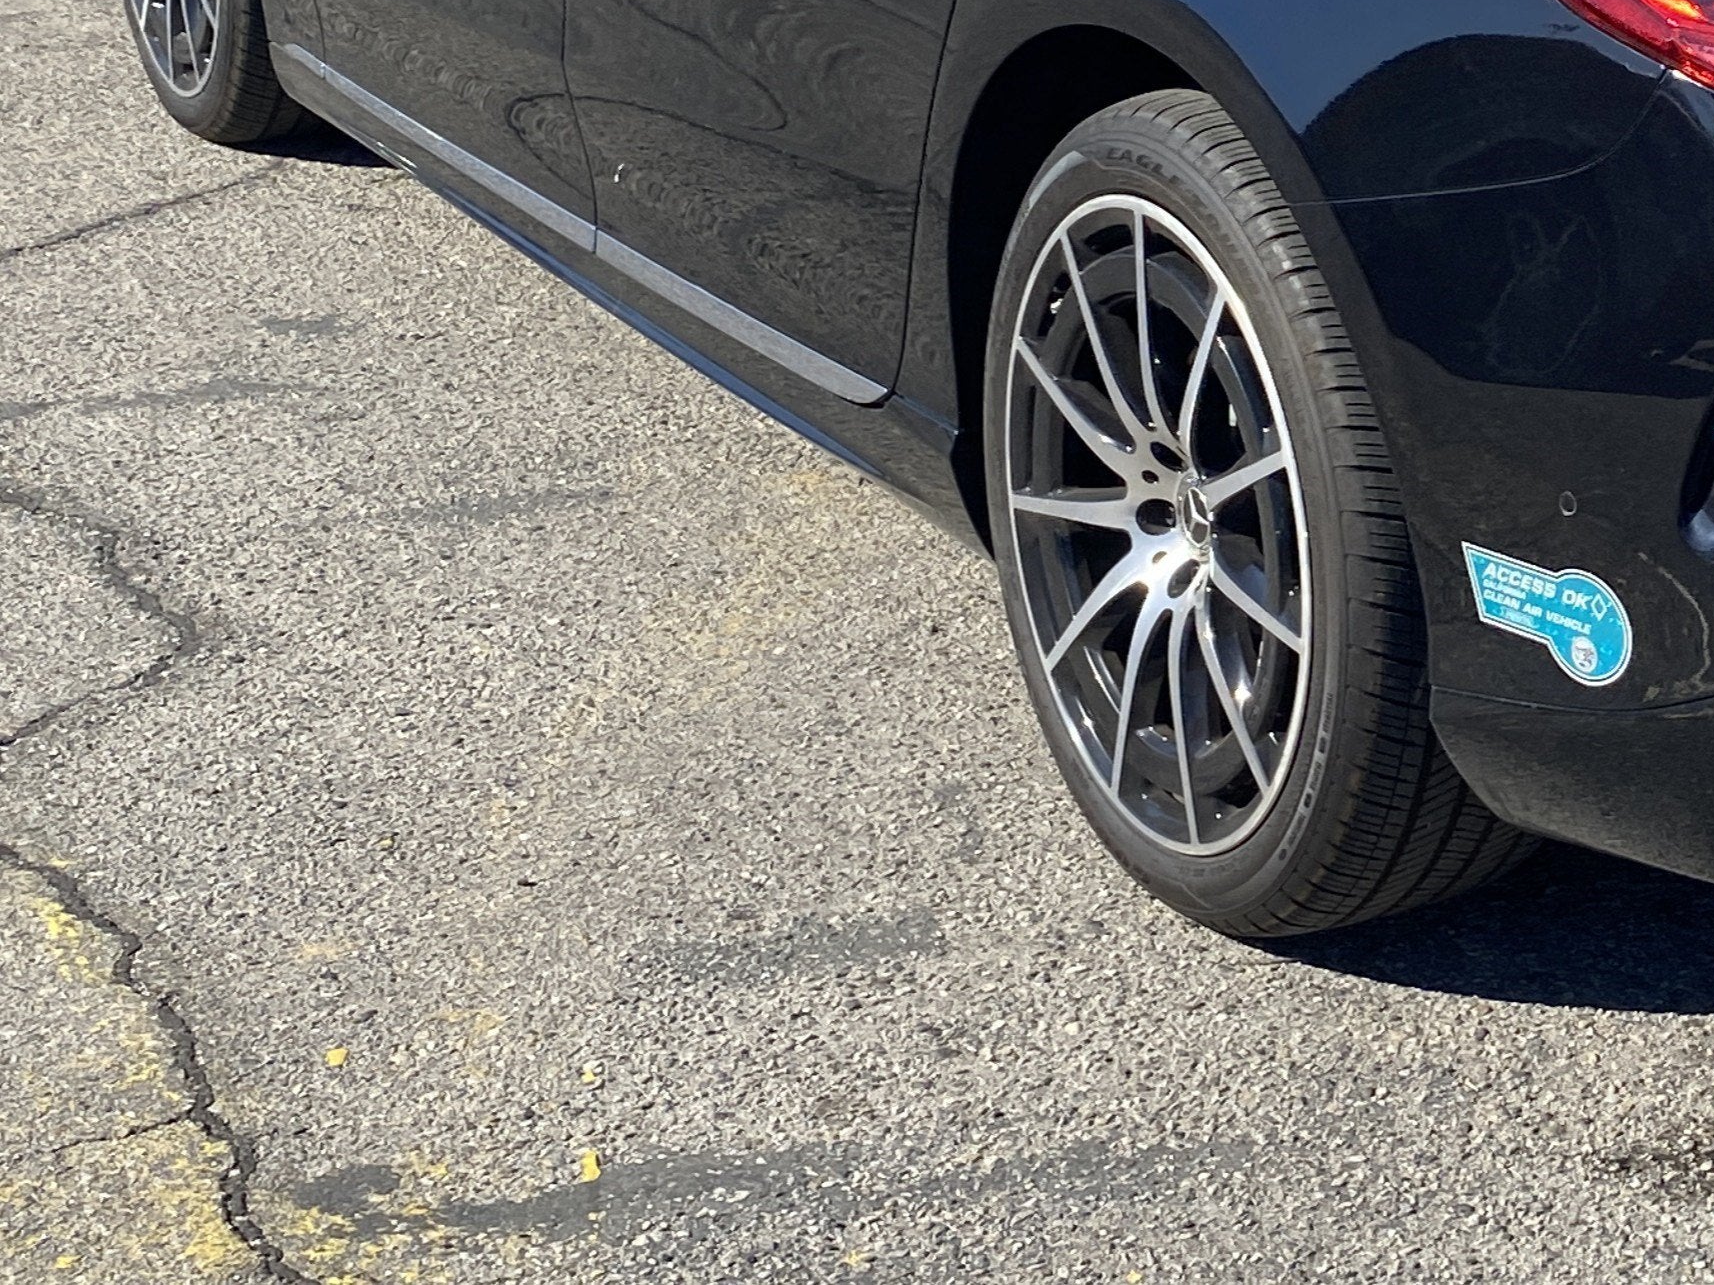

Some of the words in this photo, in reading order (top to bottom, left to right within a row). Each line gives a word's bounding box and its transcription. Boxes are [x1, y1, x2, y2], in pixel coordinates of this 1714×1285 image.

[1482, 563, 1557, 599] ACCESS
[1561, 589, 1594, 610] OK
[1482, 588, 1521, 611] CLEAN
[1522, 602, 1543, 618] AIR
[1545, 610, 1593, 635] VEHICLE
